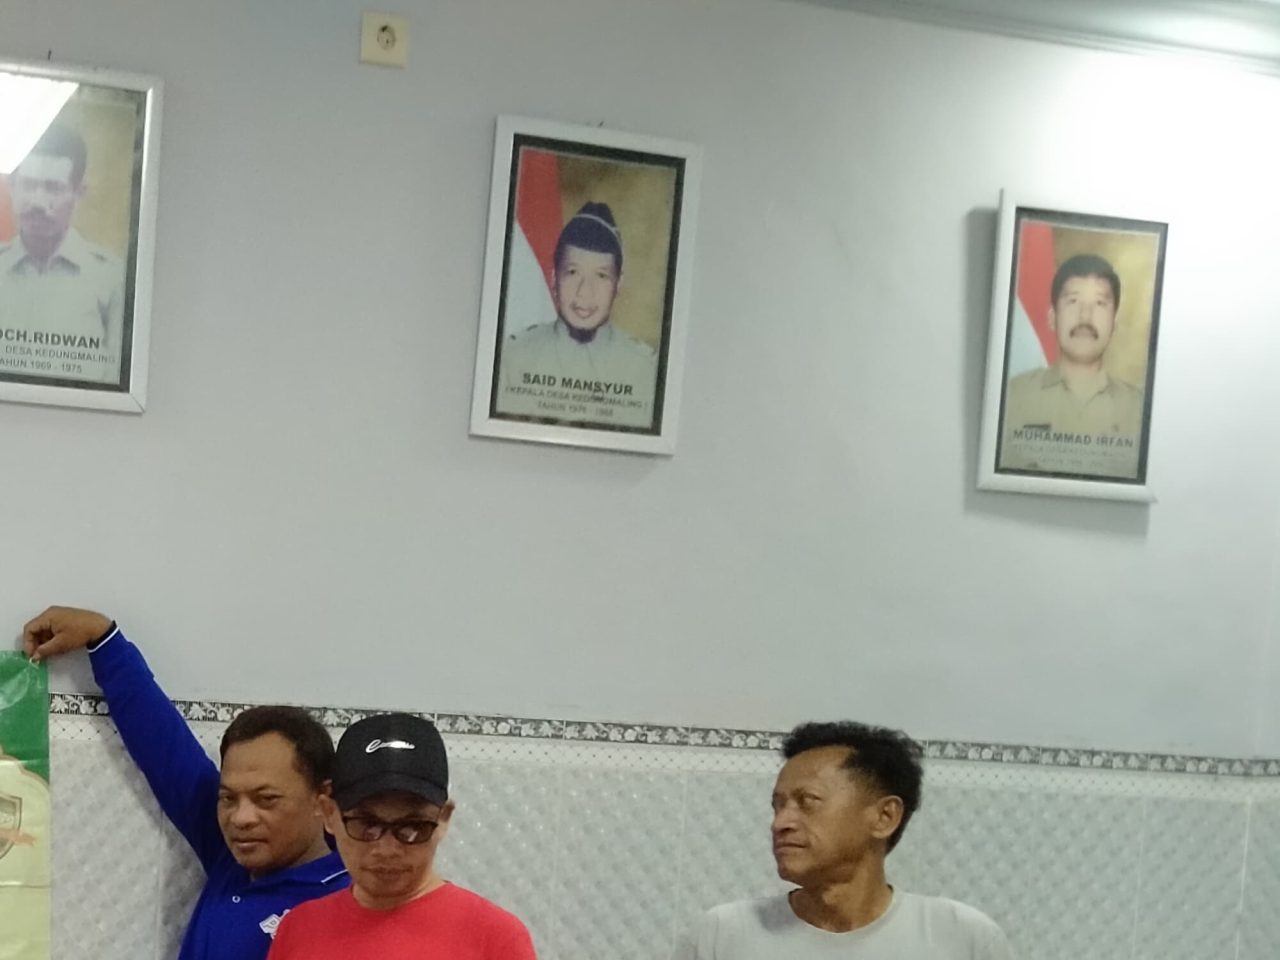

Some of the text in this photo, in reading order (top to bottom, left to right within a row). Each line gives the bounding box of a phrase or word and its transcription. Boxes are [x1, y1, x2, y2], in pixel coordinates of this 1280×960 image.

[522, 372, 633, 396] SAID MANSYUR
[1014, 429, 1133, 448] MUHAMMAD IRFAN
